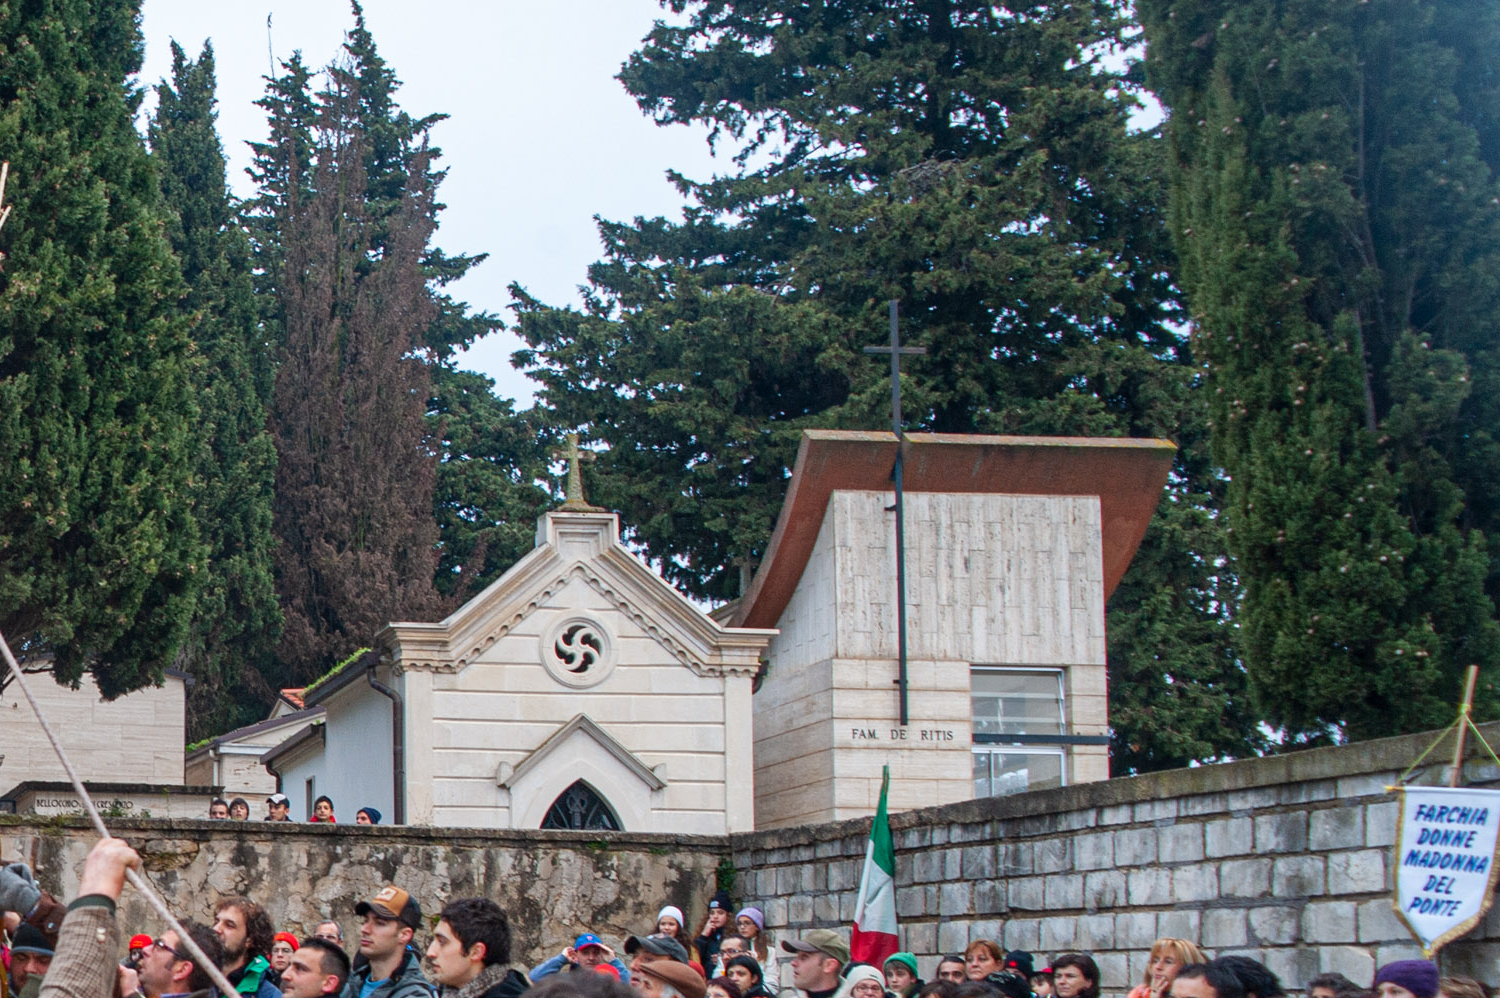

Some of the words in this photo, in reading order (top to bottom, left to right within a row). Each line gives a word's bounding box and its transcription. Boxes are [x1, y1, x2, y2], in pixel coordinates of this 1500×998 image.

[852, 728, 879, 740] FAM.
[890, 728, 908, 740] DE
[920, 729, 954, 741] RITIS
[1414, 804, 1489, 826] FARCHIA
[1416, 828, 1478, 848] DONNE
[1404, 849, 1489, 874] MADONNA
[1423, 874, 1457, 895] DEL
[1407, 897, 1463, 917] PONTE
